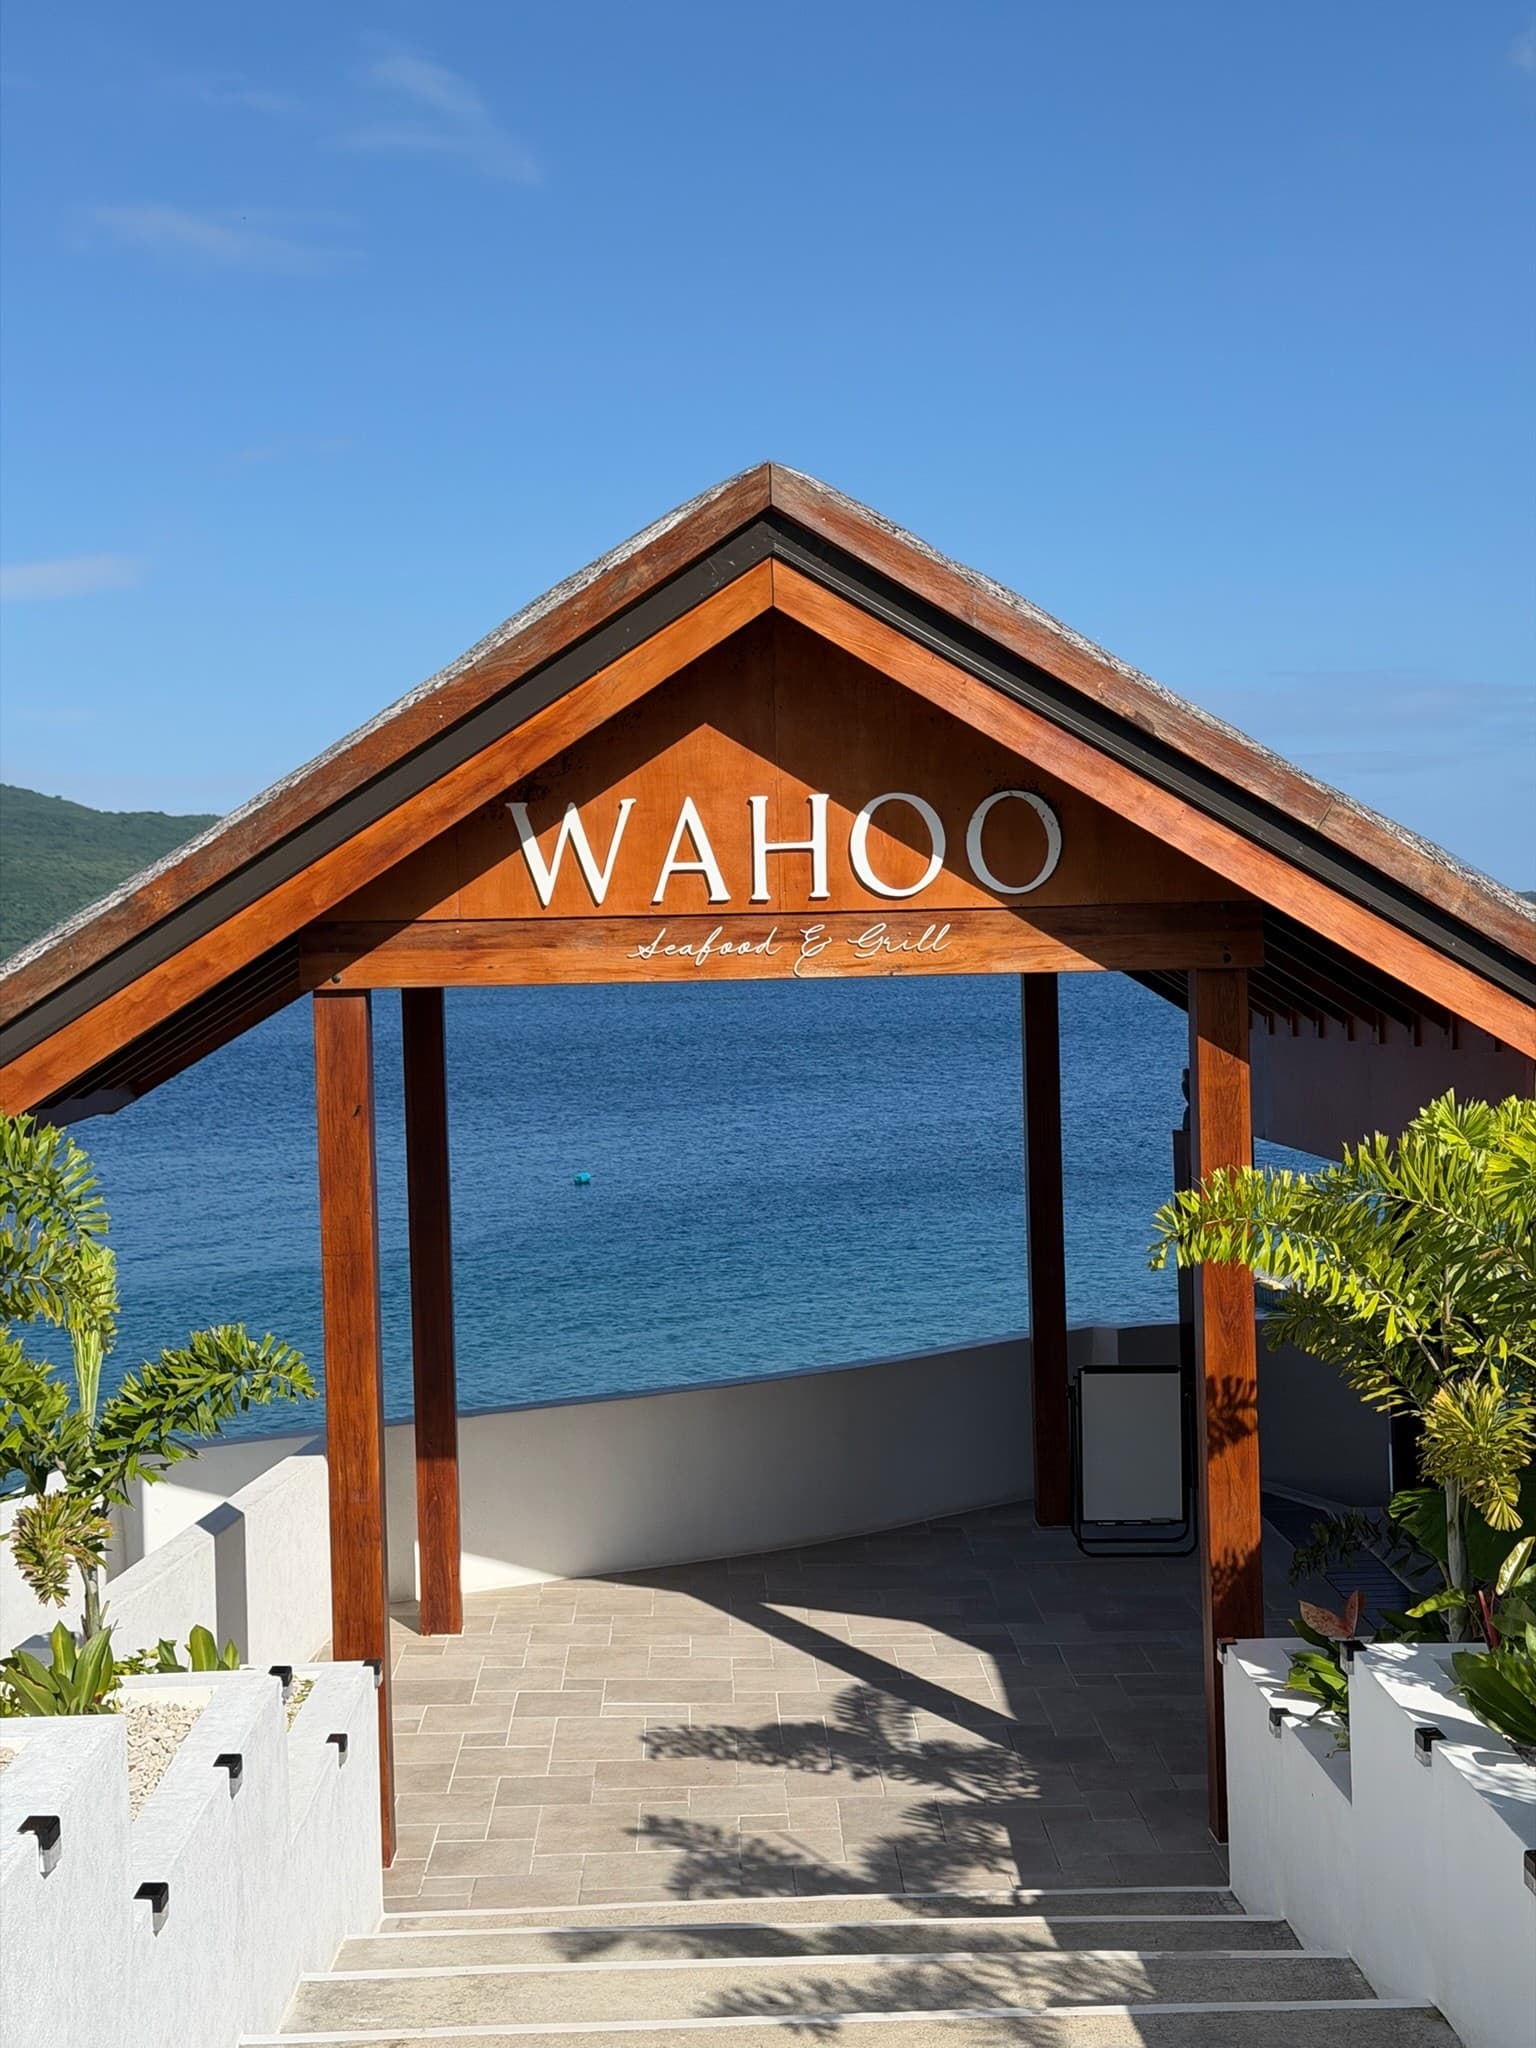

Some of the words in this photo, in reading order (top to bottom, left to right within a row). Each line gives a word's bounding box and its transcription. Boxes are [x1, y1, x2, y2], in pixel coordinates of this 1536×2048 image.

[505, 790, 1062, 908] WAHOO
[627, 926, 783, 967] Seafood
[794, 924, 832, 977] &
[848, 922, 951, 957] Grill
